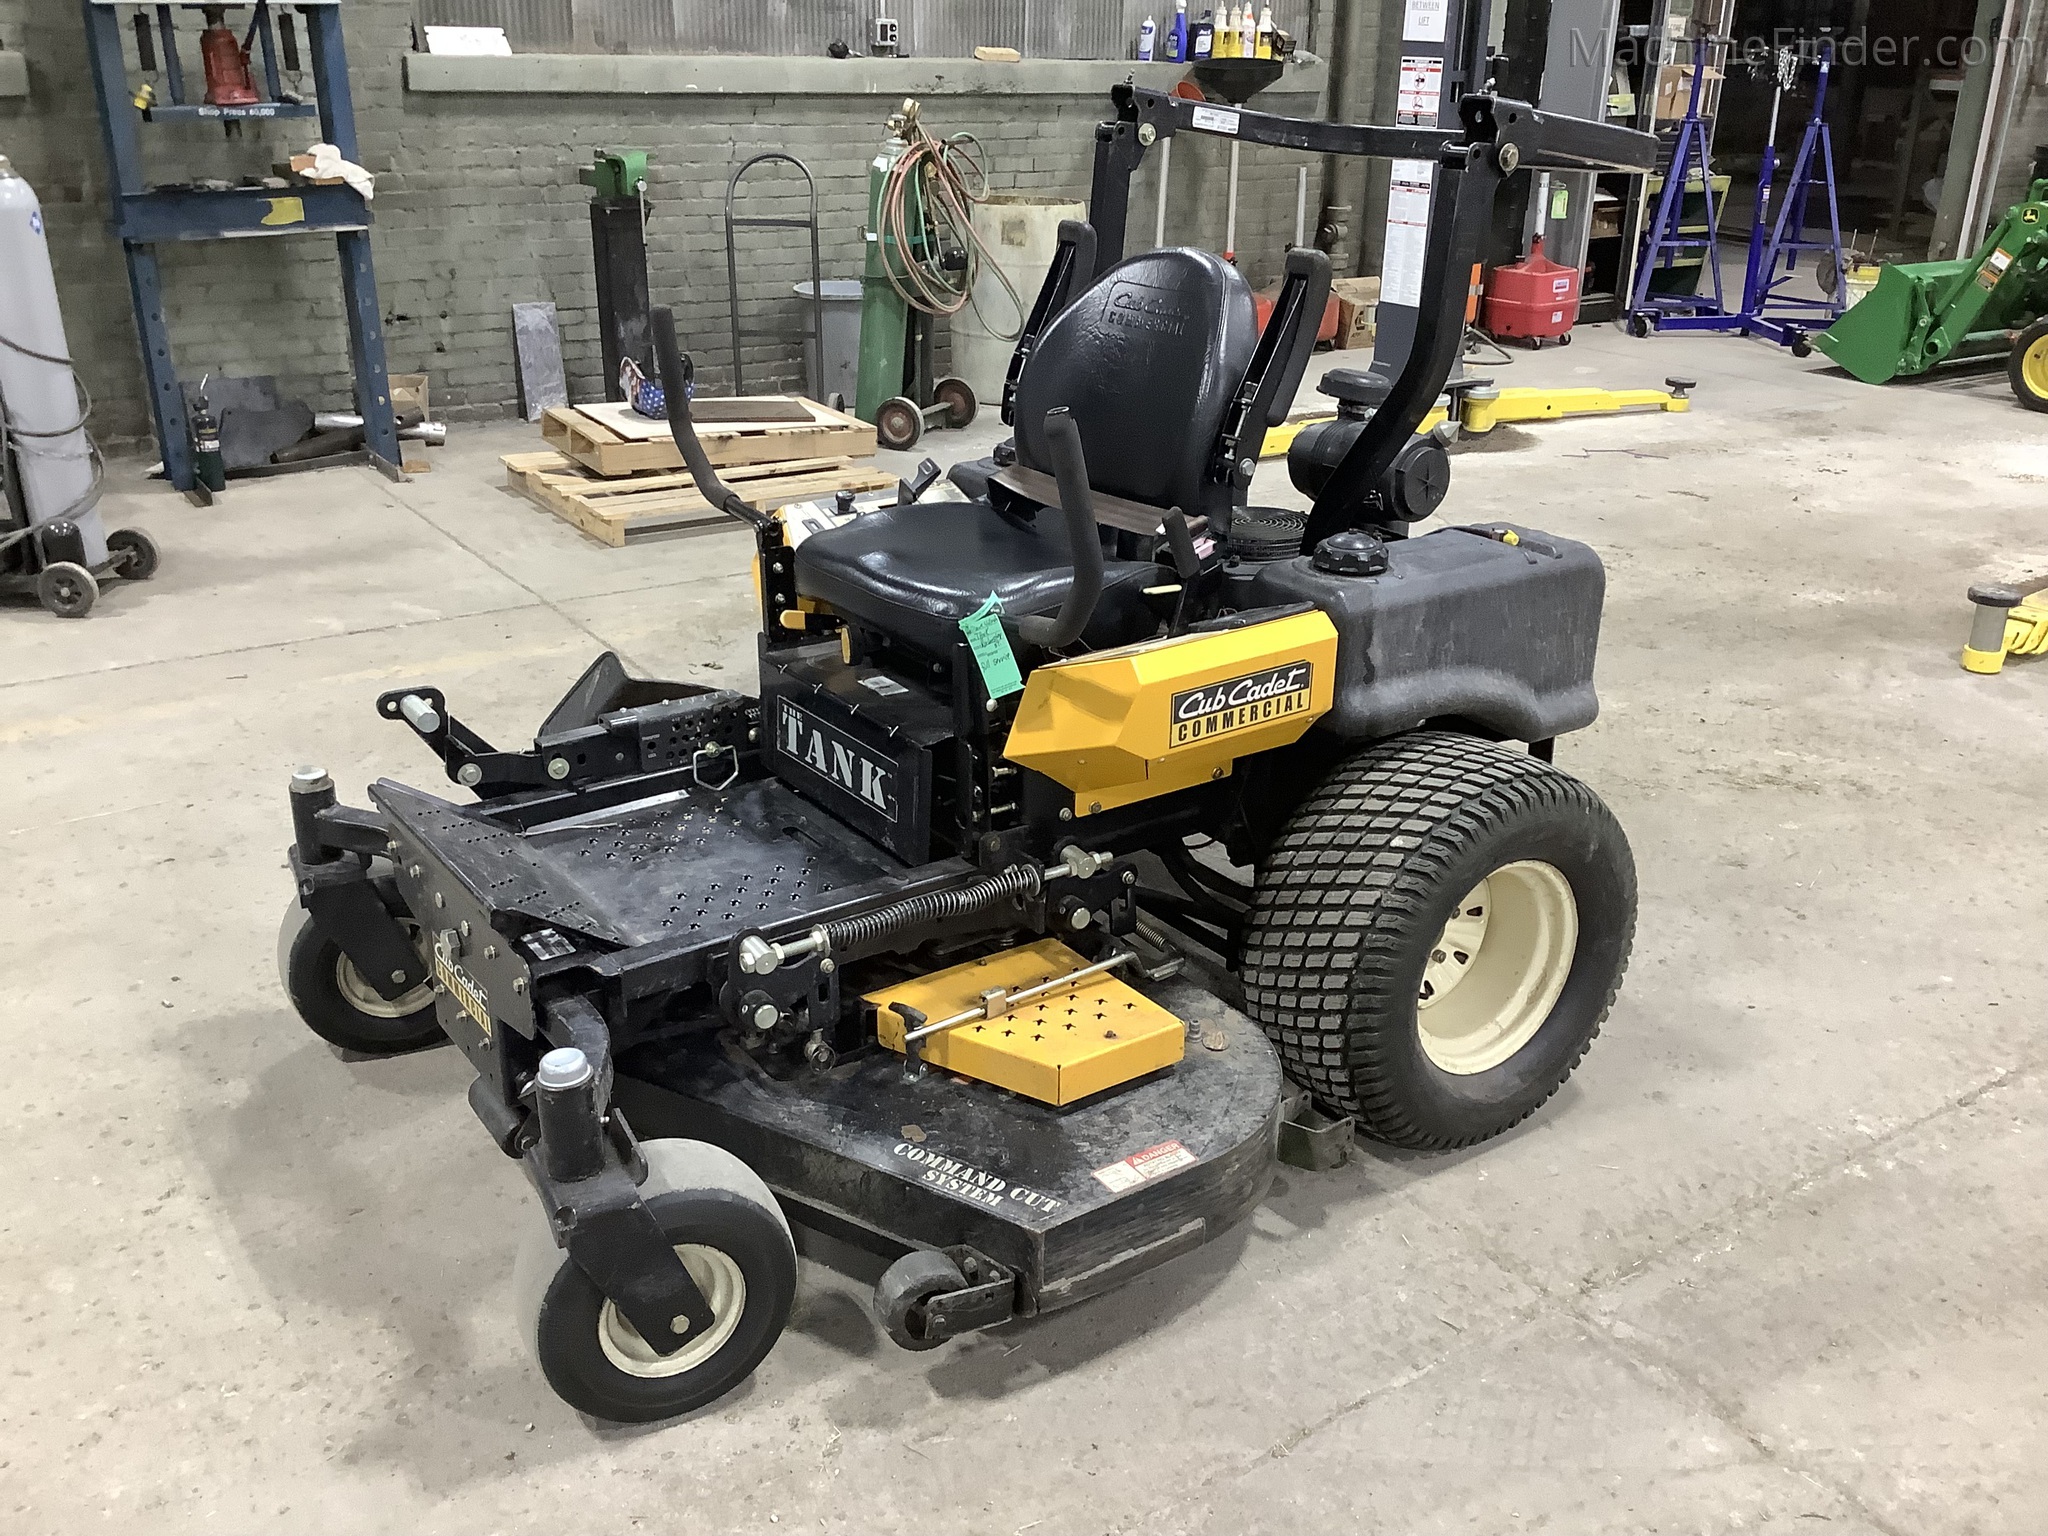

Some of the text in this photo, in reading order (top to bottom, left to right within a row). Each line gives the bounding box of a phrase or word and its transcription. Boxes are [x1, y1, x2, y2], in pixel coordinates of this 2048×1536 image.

[1411, 0, 1440, 10] BETWEEN
[1418, 16, 1430, 25] LIFT
[198, 107, 220, 117] Shop
[223, 107, 247, 116] Press
[782, 703, 803, 721] THE
[1178, 667, 1307, 720] Cub Cadet
[1177, 691, 1304, 742] COMMERCIAL
[782, 711, 887, 810] TANK
[454, 964, 488, 1012] Cadet
[1141, 1142, 1181, 1161] DANGER
[893, 1142, 1062, 1213] COMMAND CUT
[921, 1169, 1005, 1207] SYSTEM
